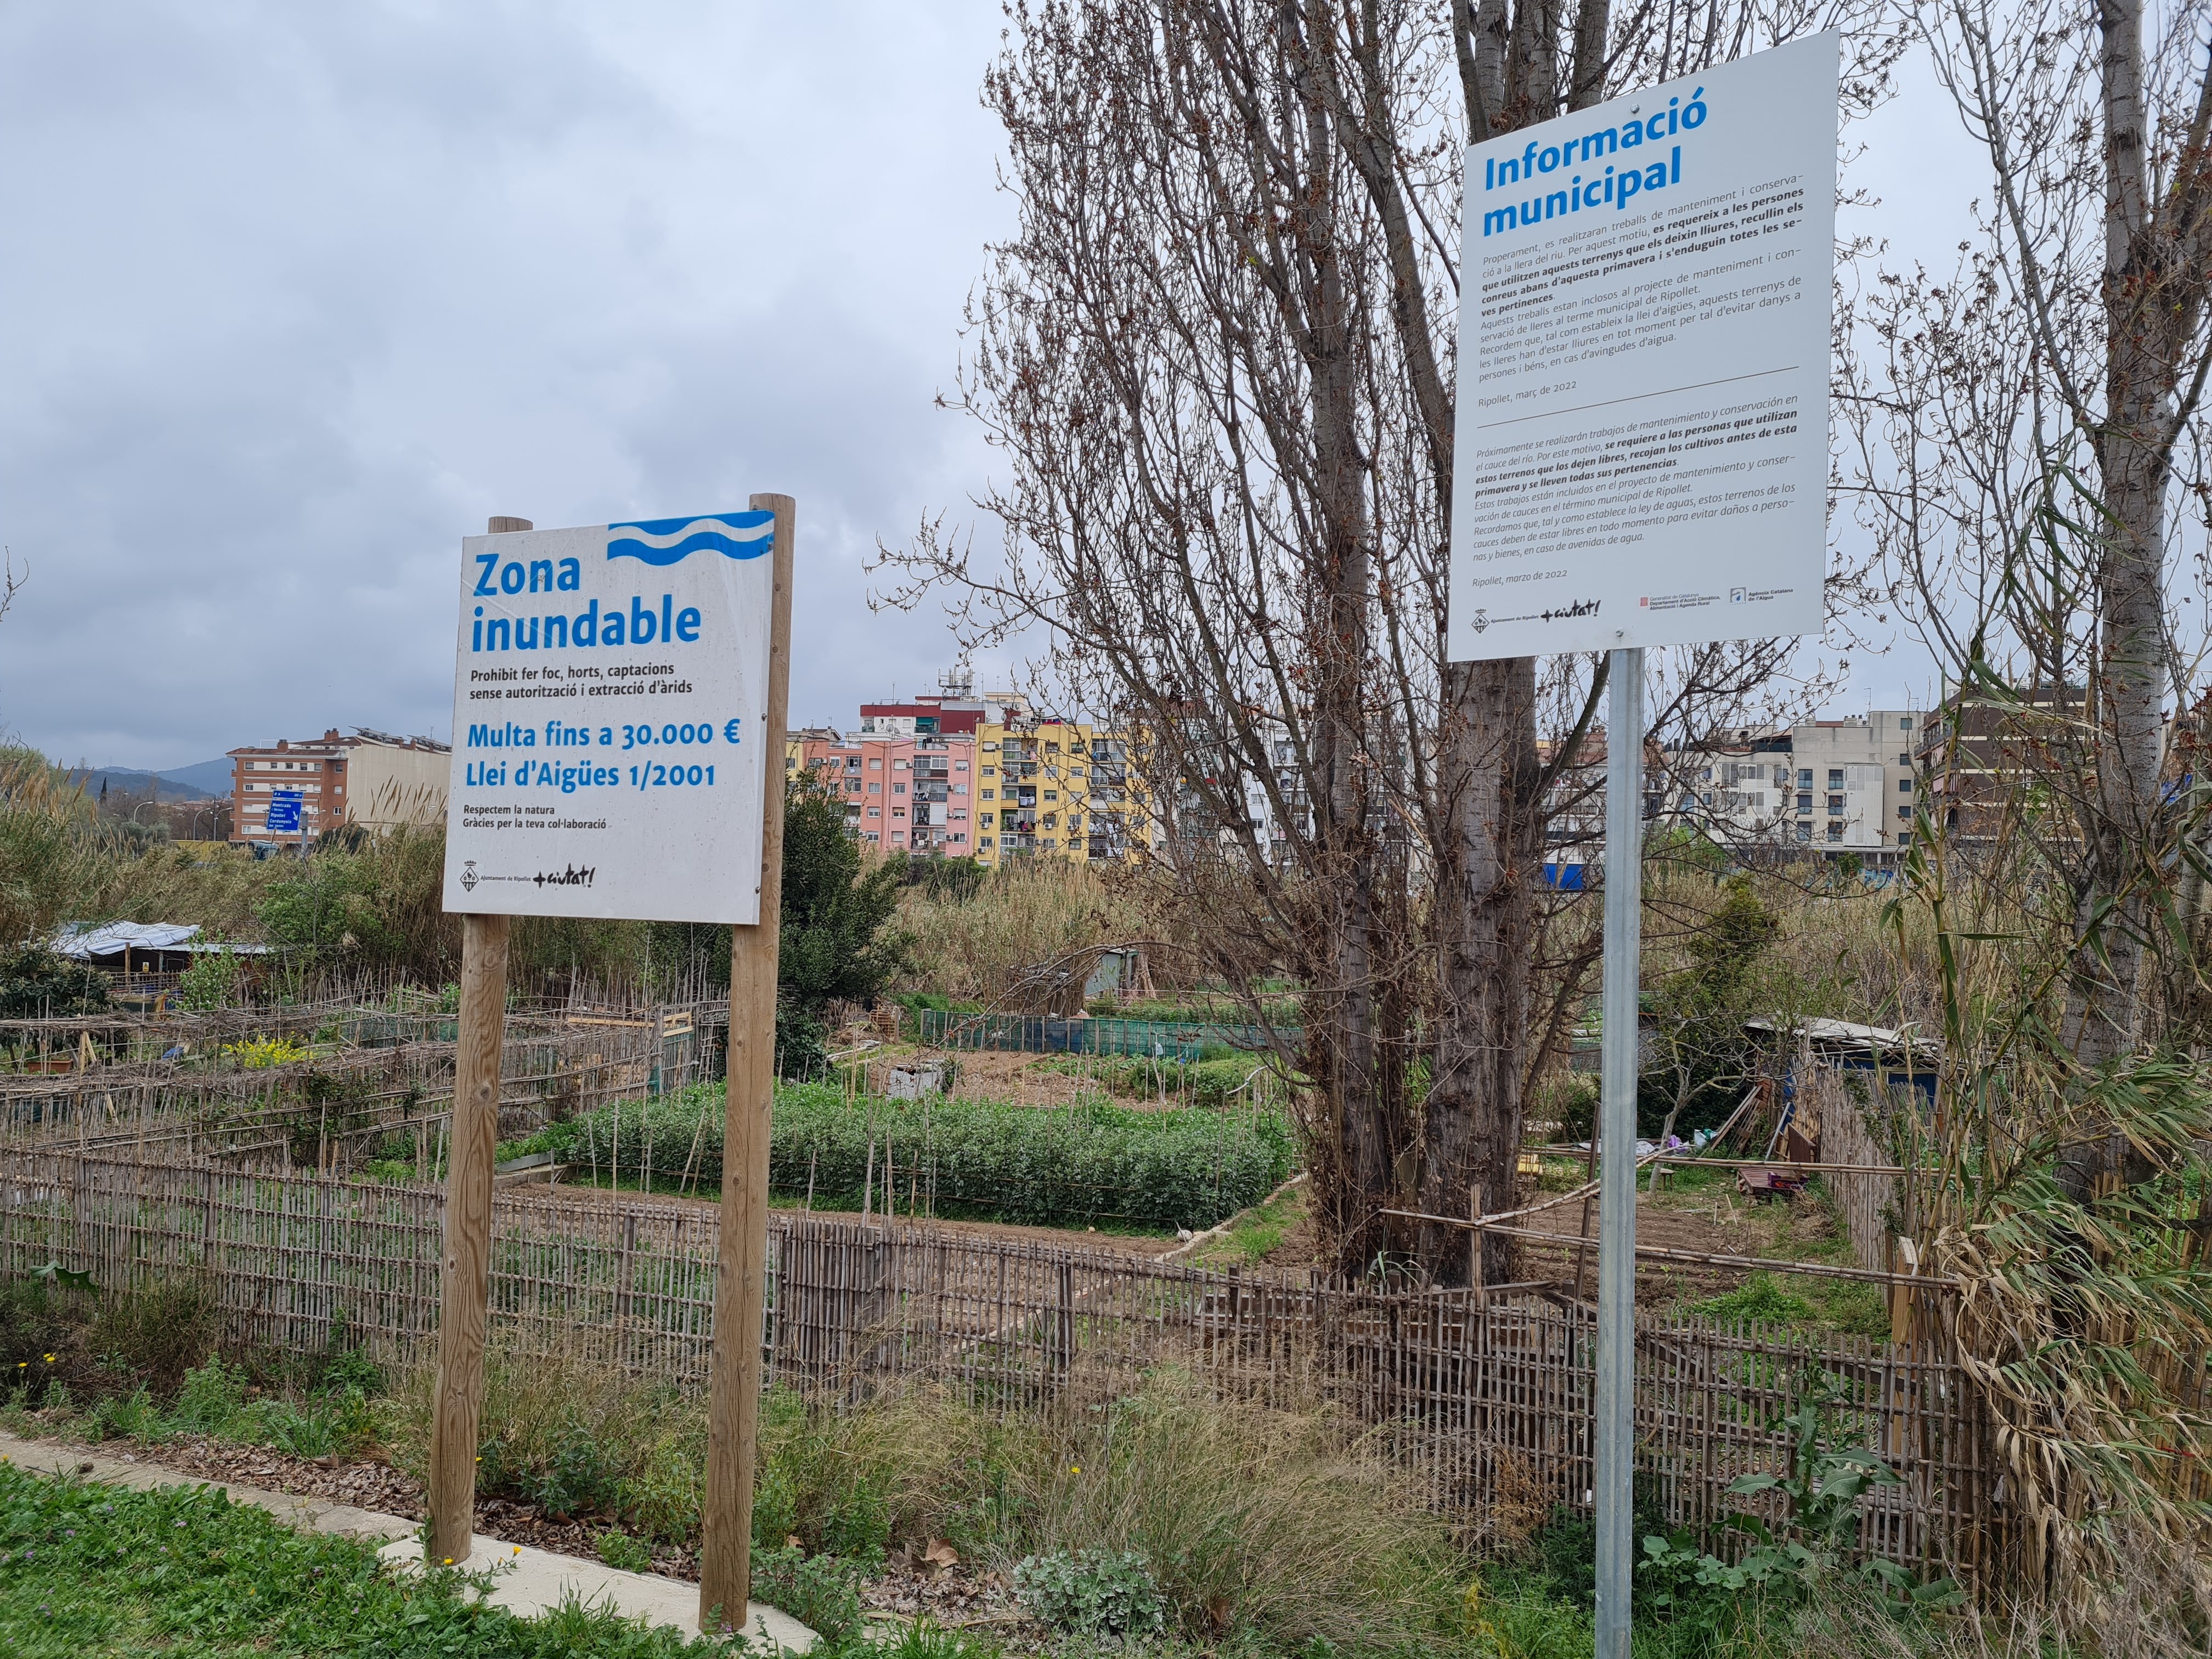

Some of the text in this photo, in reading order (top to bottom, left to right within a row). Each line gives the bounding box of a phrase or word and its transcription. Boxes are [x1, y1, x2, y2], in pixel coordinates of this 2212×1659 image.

[1486, 86, 1707, 190] Informació
[1483, 145, 1680, 236] municipal
[1482, 267, 1494, 278] ció
[1505, 264, 1511, 272] la
[1515, 259, 1532, 269] llera
[1535, 253, 1548, 264] del
[1551, 251, 1565, 260] riu.
[1568, 246, 1583, 256] Per
[1585, 237, 1616, 251] aquest
[1620, 228, 1650, 242] motiu,
[1653, 225, 1664, 233] es
[1668, 210, 1719, 230] requereix
[1722, 207, 1729, 216] a
[1733, 203, 1747, 213] les
[1752, 188, 1803, 211] persones
[1483, 175, 1803, 265] Properament, es realitzaran treballs de manteniment i conserva-
[1482, 202, 1803, 292] que utilitzen aquests terrenys que els deixin lliures, recullin els
[1482, 219, 1802, 303] conreus abans d'aquesta primavera i s'enduguin totes les se-
[1481, 249, 1801, 330] Aquests treballs estan inclosos al projecte de manteniment i con-
[1481, 294, 1555, 317] ves pertinences.
[1479, 381, 1576, 408] Ripollet, març de 2022
[1476, 462, 1483, 471] el
[1485, 460, 1506, 470] cauce
[1508, 456, 1520, 466] del
[1522, 454, 1534, 463] río.
[1537, 452, 1551, 461] Por
[1553, 449, 1569, 458] este
[1571, 443, 1602, 455] motivo,
[1617, 434, 1657, 448] requiere
[1659, 432, 1666, 441] a
[1668, 429, 1683, 438] las
[1684, 422, 1731, 438] personas
[1734, 418, 1753, 430] que
[1756, 410, 1797, 424] utilizan
[1476, 425, 1797, 484] estos terrenos que los dejen libres, recojan los cultivos antes de esta
[1475, 484, 1520, 499] primavera
[1521, 483, 1527, 492] y
[1540, 477, 1567, 487] lleven
[1570, 471, 1594, 482] todas
[1596, 470, 1612, 478] sus
[1614, 458, 1679, 477] pertenencias.
[473, 553, 580, 596] Zona
[1472, 570, 1567, 588] Ripollet, marzo de 2022
[472, 594, 701, 652] inundable
[470, 679, 692, 699] sense autorització i extracció d'àrids
[471, 662, 674, 681] Prohibit fer foc, horts, captacions
[467, 718, 740, 750] Multa fins a 30.000 €
[466, 759, 714, 793] Llei d'Aigües 1/2001
[462, 817, 494, 827] Gràcies
[497, 820, 512, 830] per
[515, 818, 522, 827] la
[526, 820, 544, 828] teva
[464, 804, 554, 816] Respectem la natura
